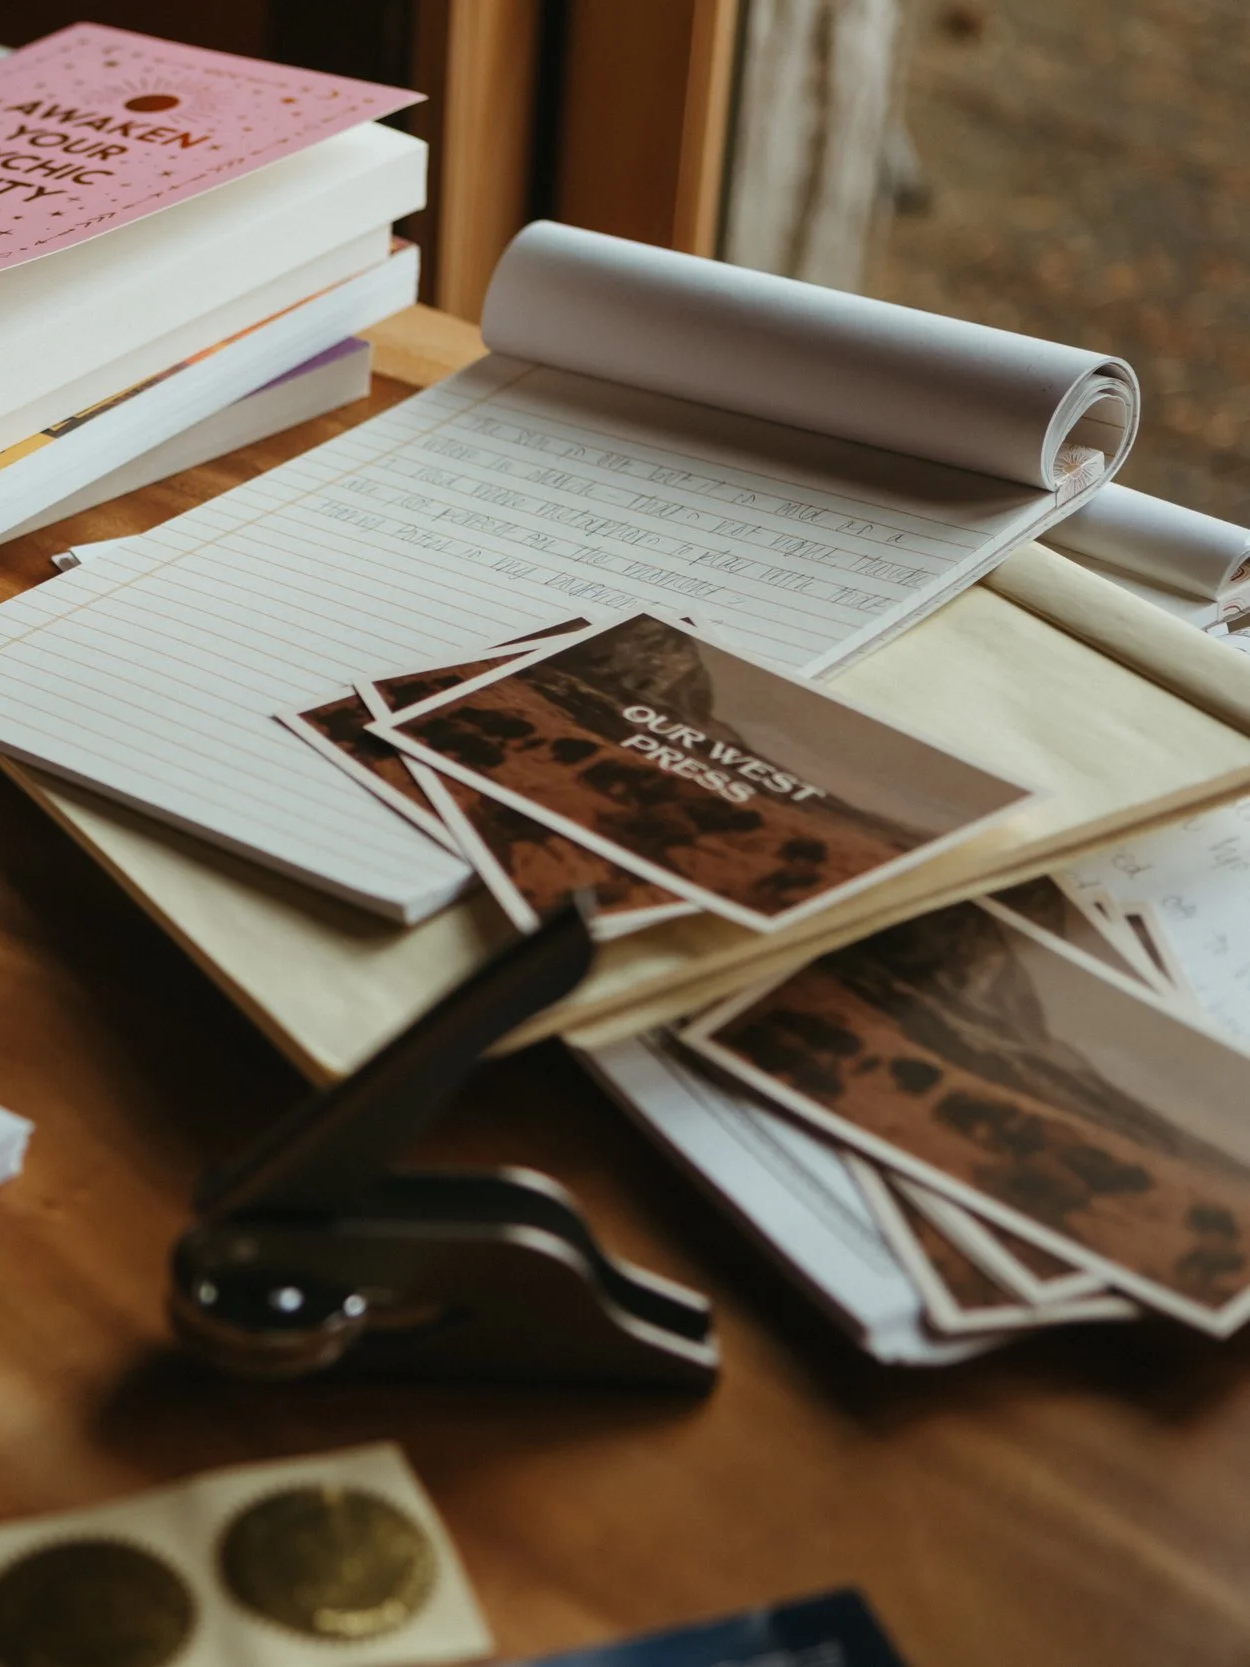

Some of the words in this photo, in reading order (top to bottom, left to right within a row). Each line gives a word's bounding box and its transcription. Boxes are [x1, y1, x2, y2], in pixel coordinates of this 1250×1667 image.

[4, 98, 210, 151] AWAKEN
[4, 123, 130, 162] YOUR
[649, 466, 692, 488] but
[696, 481, 726, 496] it
[774, 502, 829, 523] cold
[836, 520, 873, 536] as
[885, 533, 904, 545] a
[710, 519, 762, 538] not
[393, 522, 454, 552] Potter
[464, 548, 483, 560] is
[488, 556, 538, 581] my
[472, 481, 526, 507] more
[535, 502, 661, 546] metaphors
[670, 542, 693, 556] to
[688, 549, 755, 575] play
[760, 566, 814, 592] with
[571, 546, 614, 566] the
[619, 733, 757, 804] PRESS
[621, 704, 707, 749] OUR
[709, 740, 827, 801] WEST
